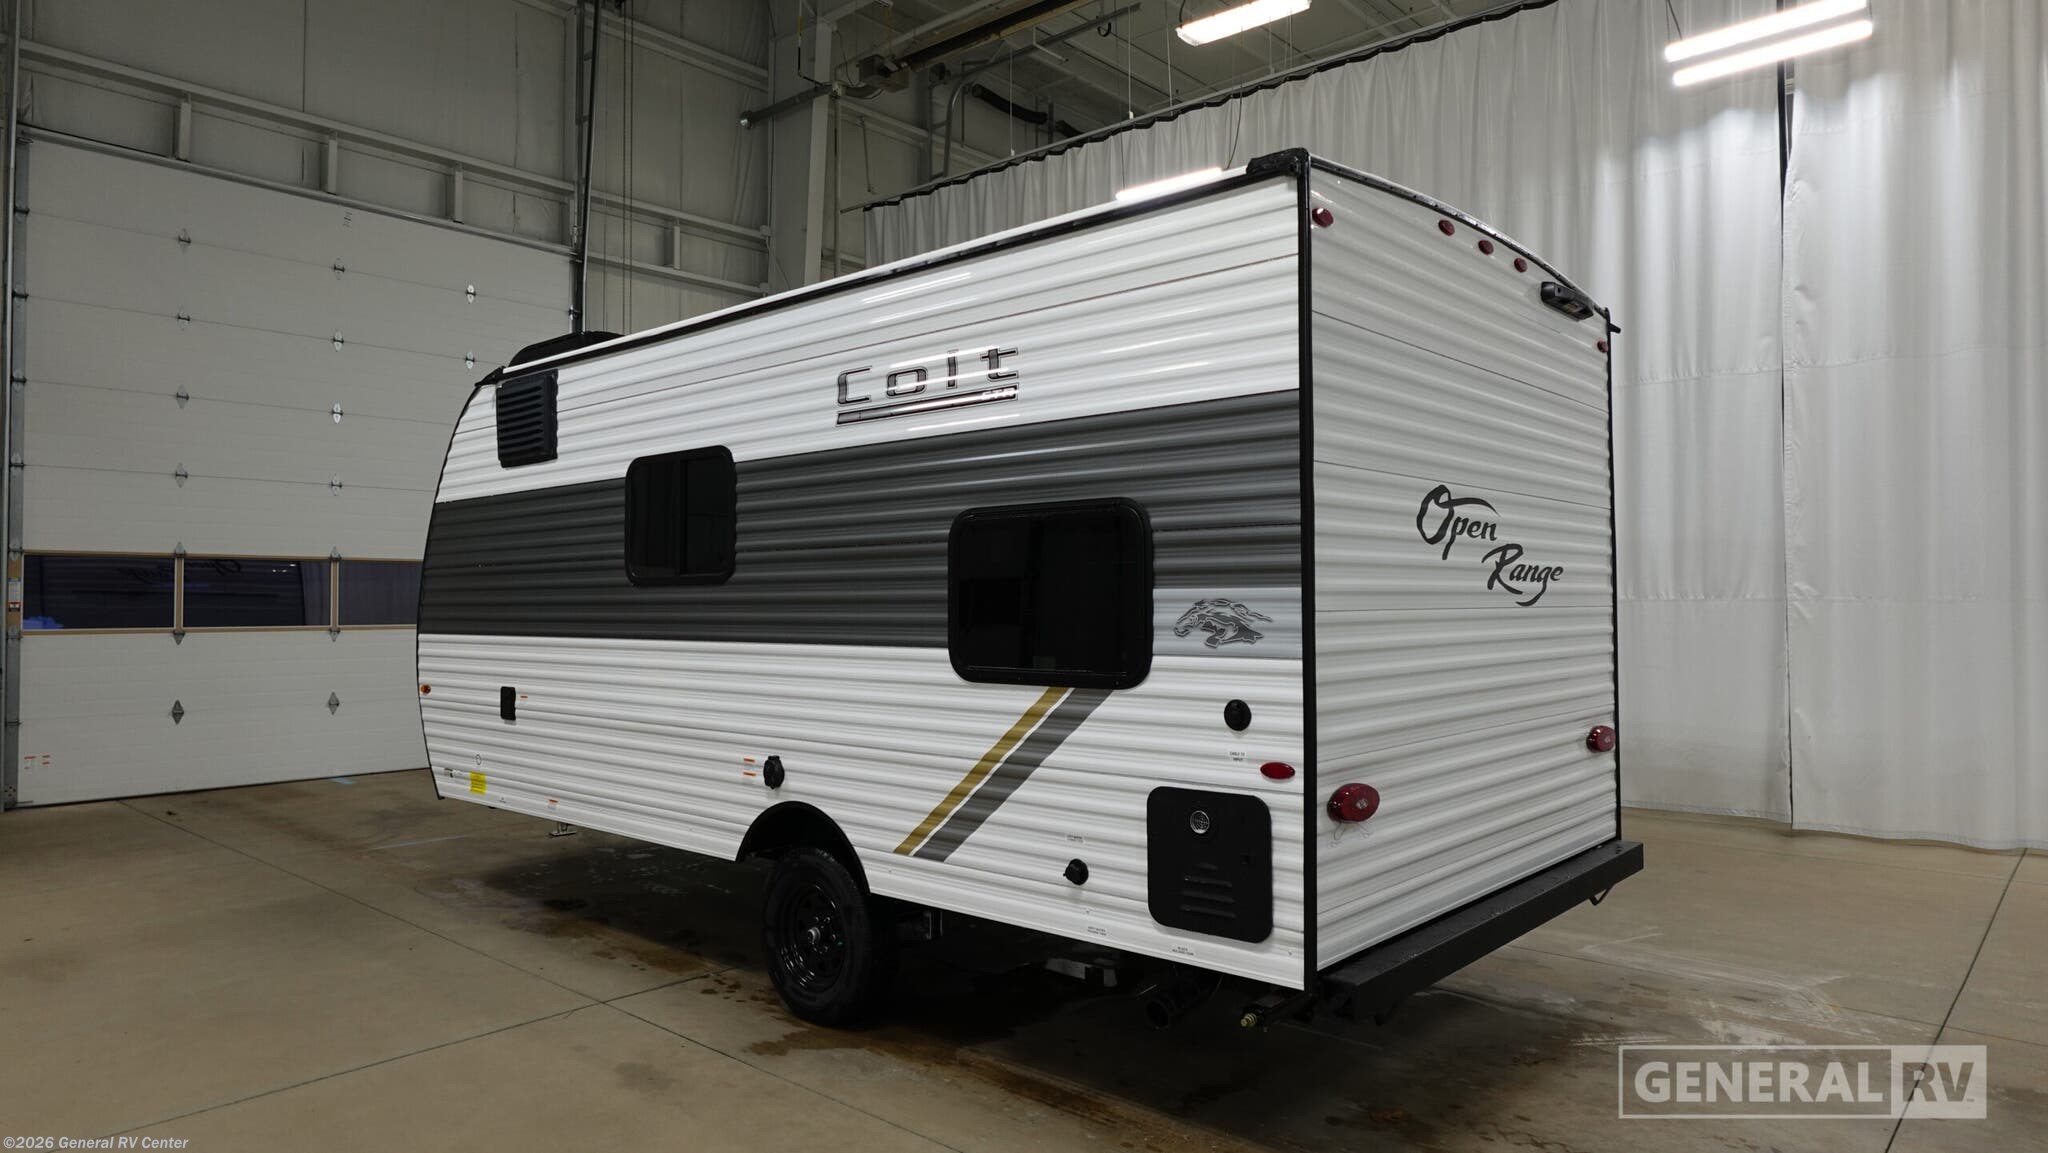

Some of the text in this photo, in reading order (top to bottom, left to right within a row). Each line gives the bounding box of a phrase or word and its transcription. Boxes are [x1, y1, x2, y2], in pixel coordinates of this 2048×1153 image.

[836, 347, 1019, 406] Colt
[1416, 484, 1501, 561] Open
[1481, 543, 1564, 607] Range
